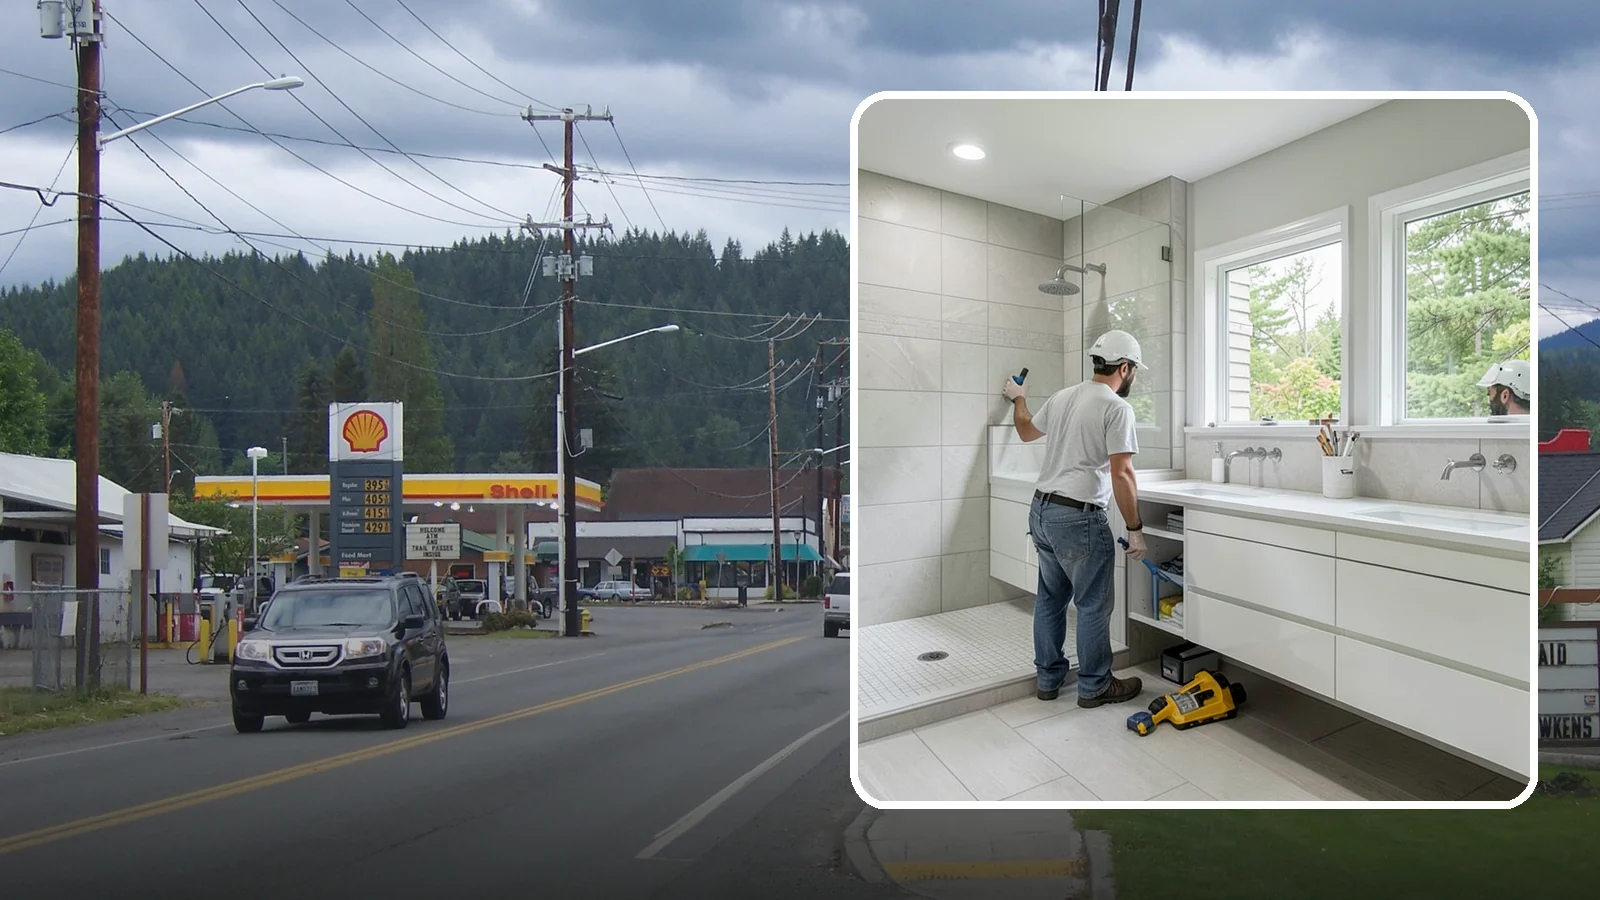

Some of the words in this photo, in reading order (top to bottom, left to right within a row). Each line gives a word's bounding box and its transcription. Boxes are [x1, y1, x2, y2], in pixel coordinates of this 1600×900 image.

[365, 480, 383, 490] 395
[490, 484, 547, 499] Shell
[365, 494, 383, 504] 405
[365, 508, 383, 518] 415
[365, 522, 383, 533] 429
[1538, 642, 1567, 665] AID
